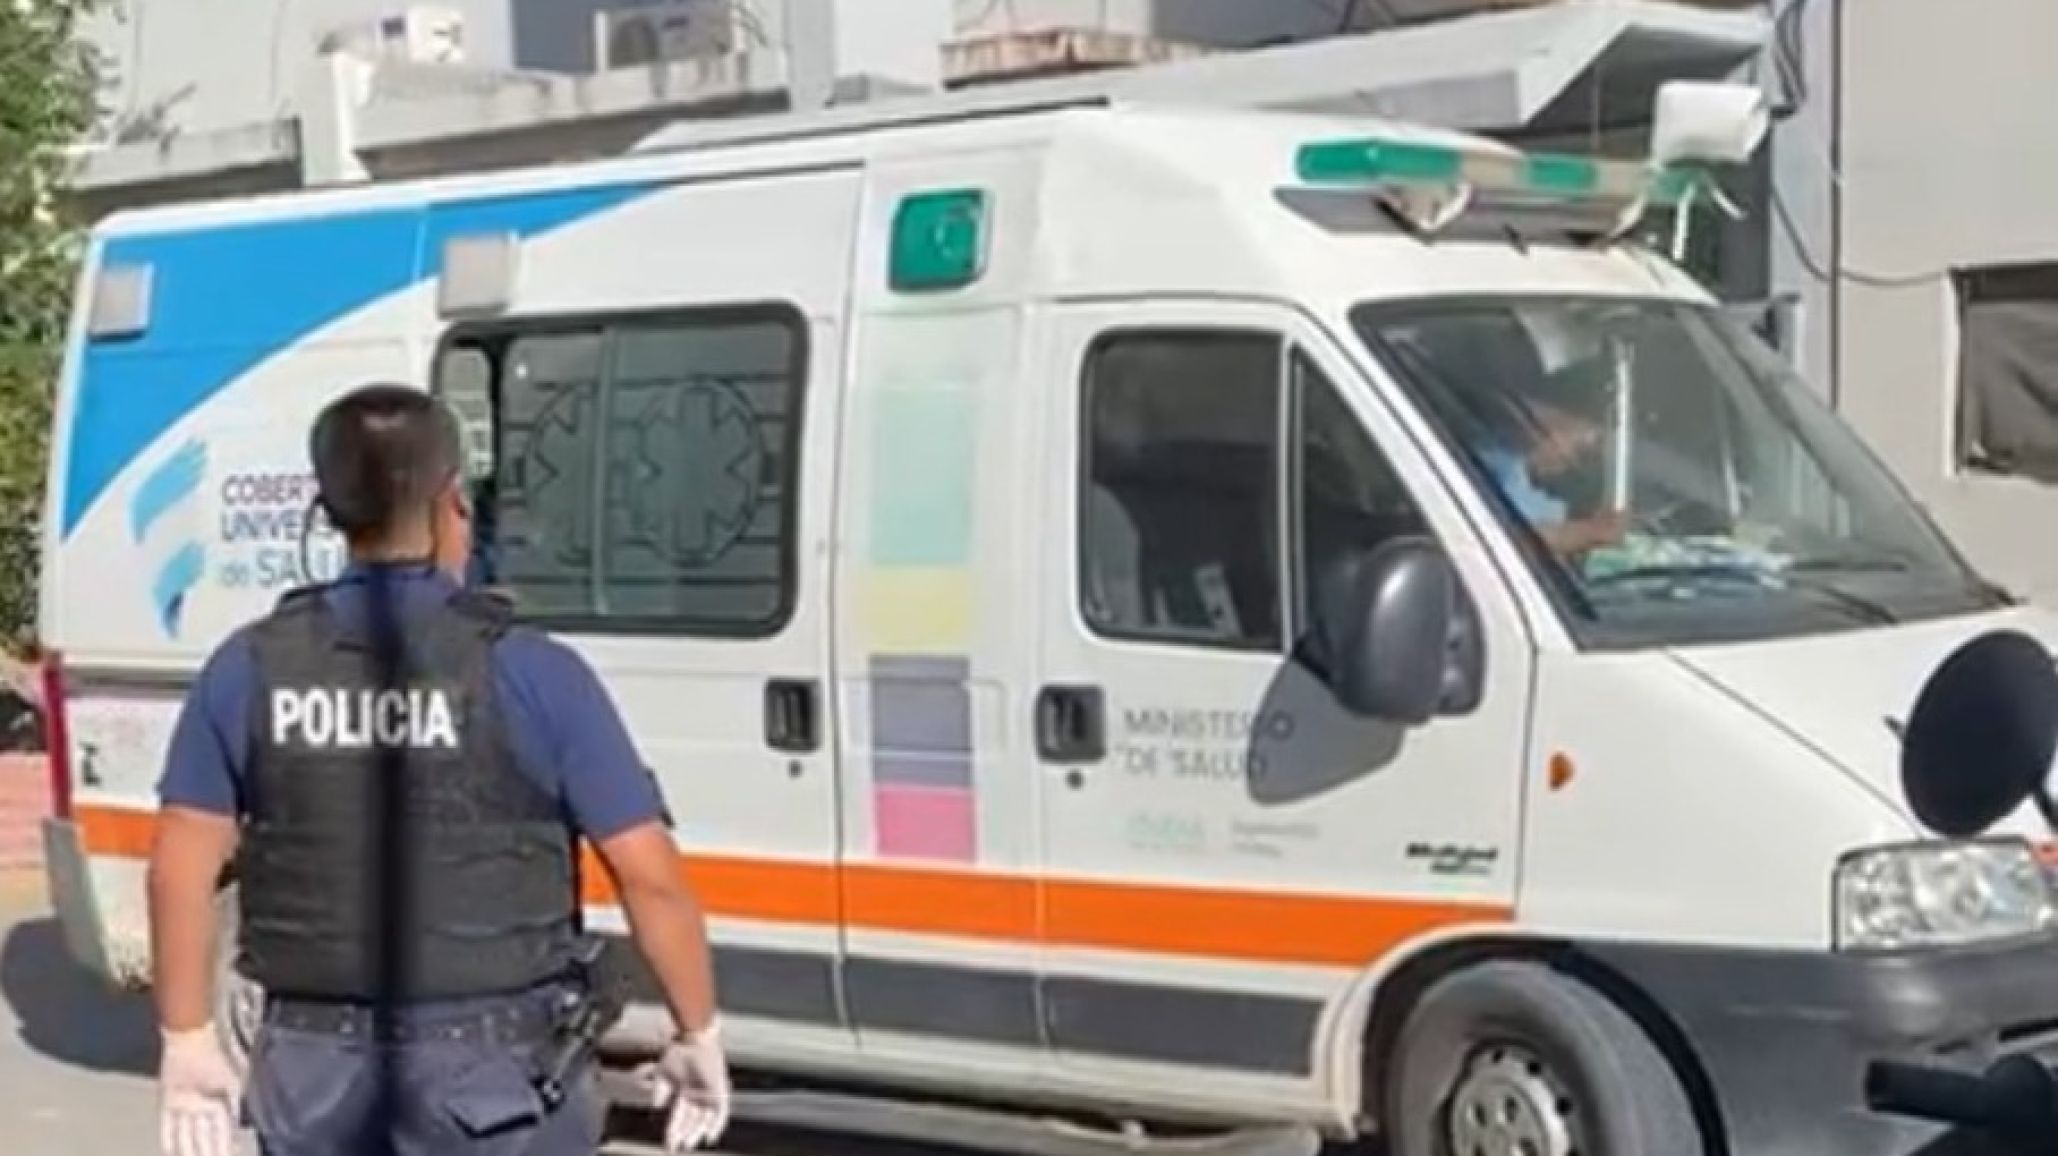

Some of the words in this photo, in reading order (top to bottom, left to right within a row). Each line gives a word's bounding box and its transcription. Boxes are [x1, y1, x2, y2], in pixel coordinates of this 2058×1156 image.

[271, 687, 457, 748] POLICIA
[1124, 709, 1295, 742] MINISTERO
[1127, 749, 1157, 778] DE
